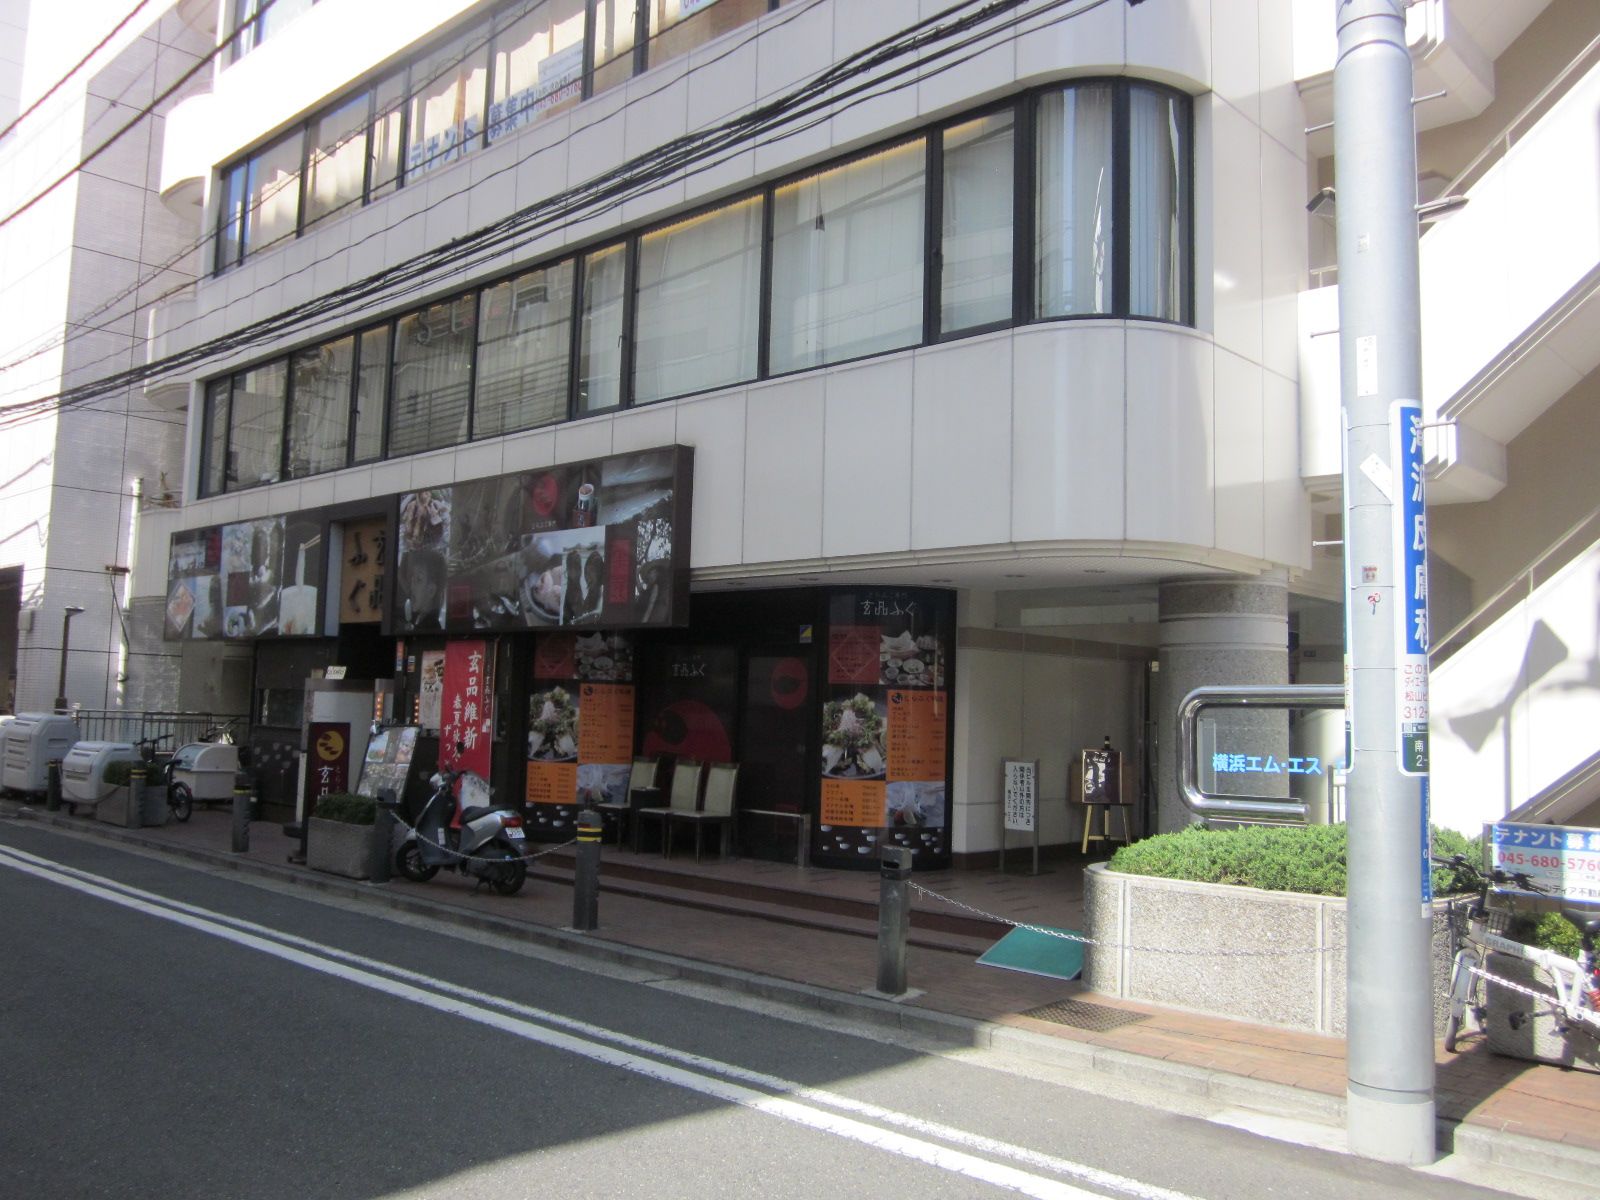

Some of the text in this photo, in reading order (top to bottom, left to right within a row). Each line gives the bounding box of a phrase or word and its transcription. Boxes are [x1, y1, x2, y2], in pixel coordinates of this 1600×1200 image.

[410, 88, 535, 175] テナント 募集中
[860, 599, 917, 617] 玄品ふぐ
[464, 650, 482, 750] 玄品維新
[1212, 753, 1322, 775] 横浜エム・エス
